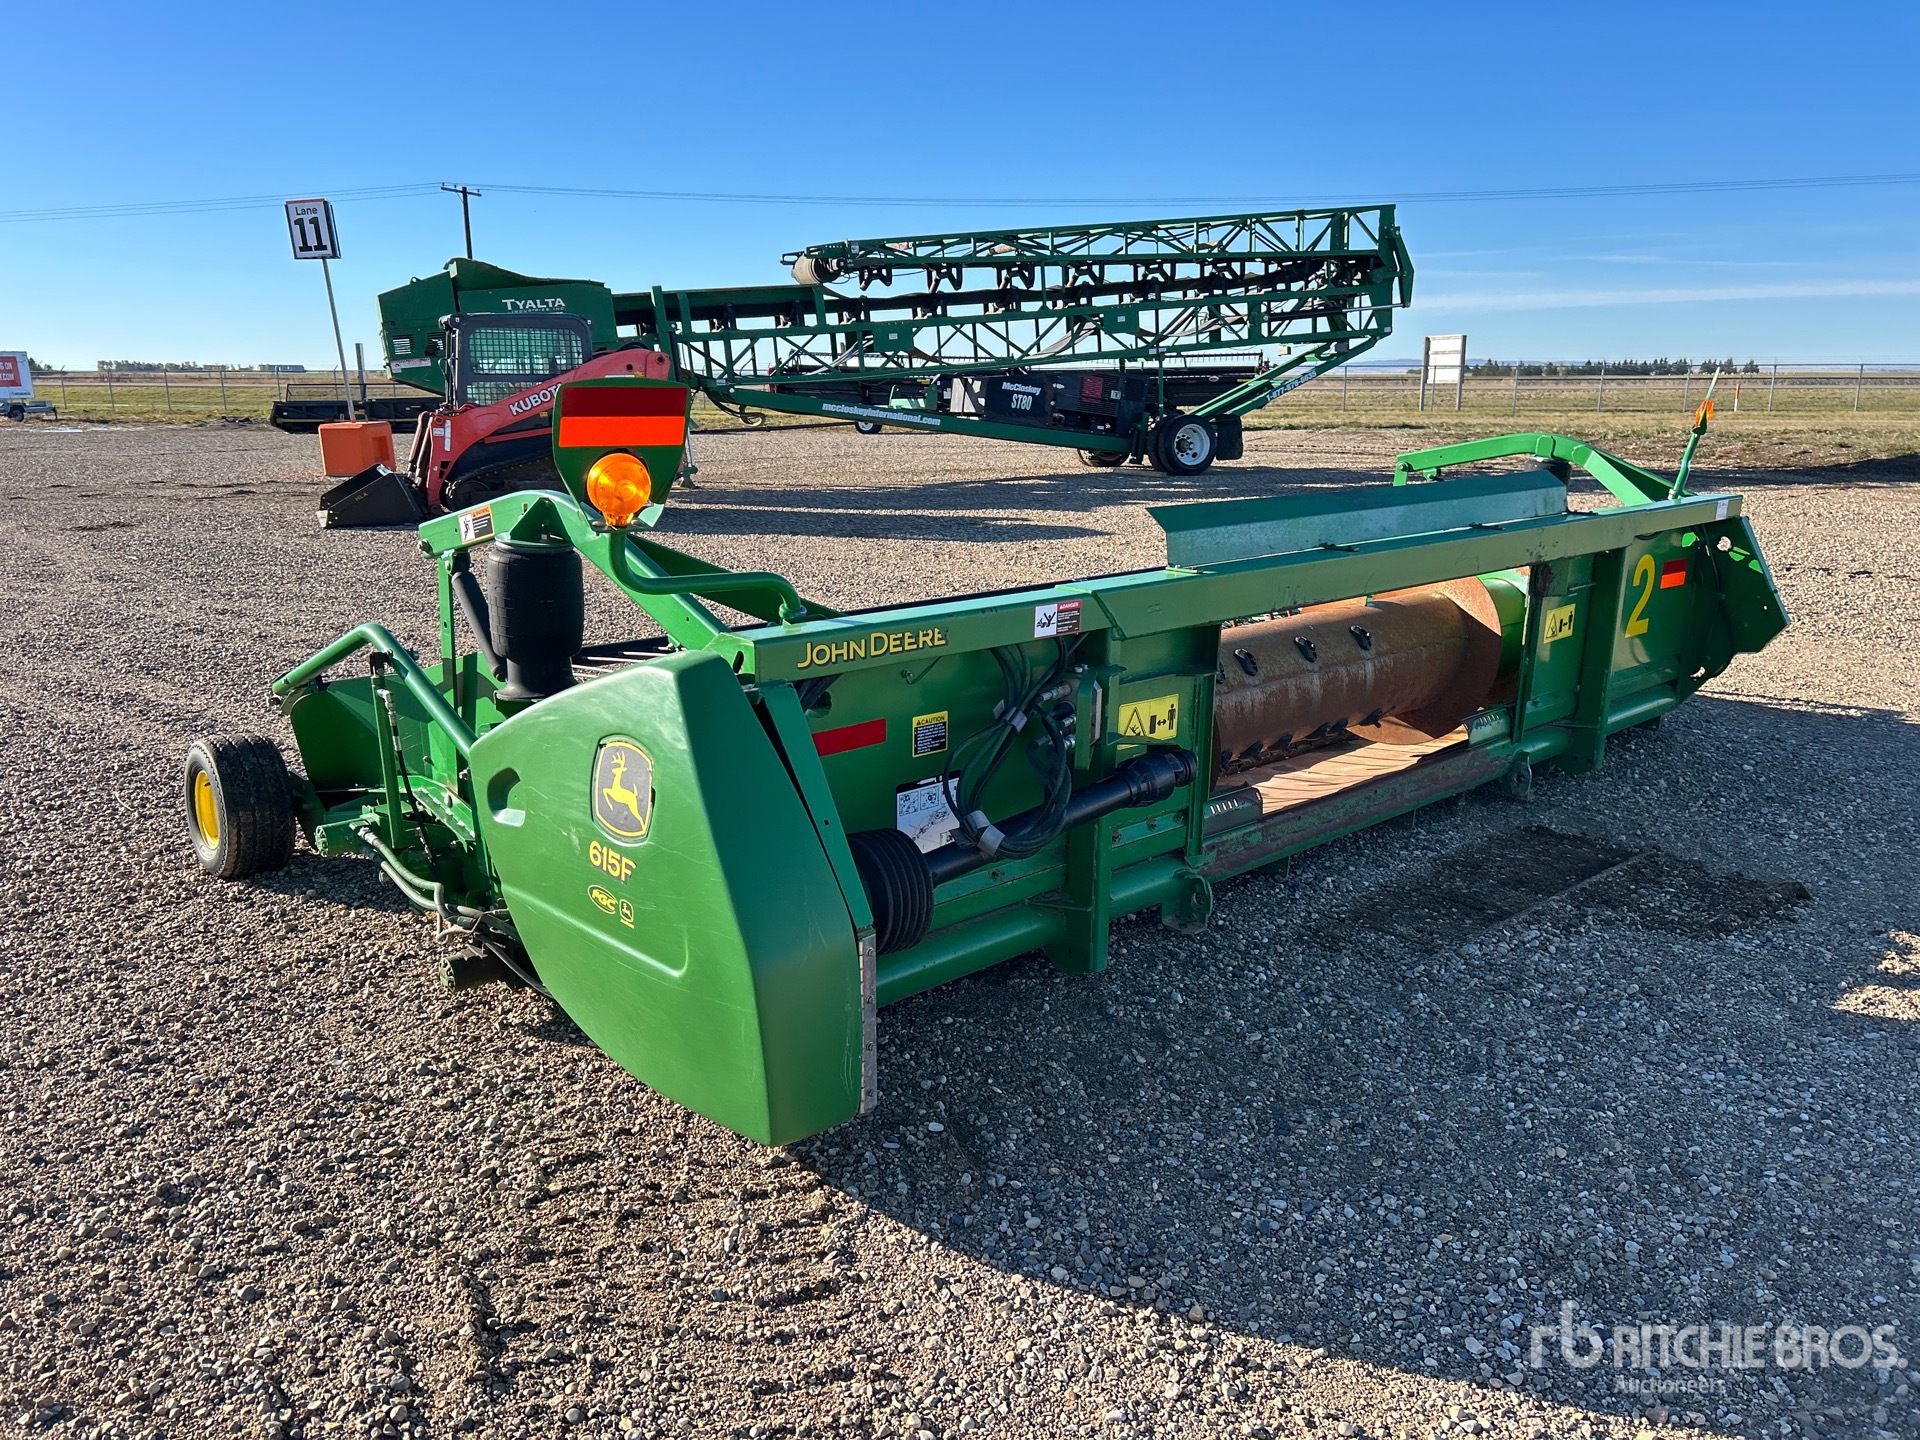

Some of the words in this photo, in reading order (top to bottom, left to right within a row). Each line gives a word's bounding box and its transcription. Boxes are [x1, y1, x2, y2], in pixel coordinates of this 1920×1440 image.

[295, 206, 318, 216] Lane
[293, 216, 328, 253] 11
[501, 297, 566, 311] TYALTA
[1001, 381, 1042, 396] McCloskey
[1010, 393, 1033, 411] ST80
[822, 402, 941, 426] mccloskeyinternational.com
[1624, 553, 1656, 639] 2
[797, 638, 866, 669] JOHN
[870, 628, 947, 657] DEERE
[920, 715, 946, 726] CAUTION
[589, 840, 637, 884] 615F
